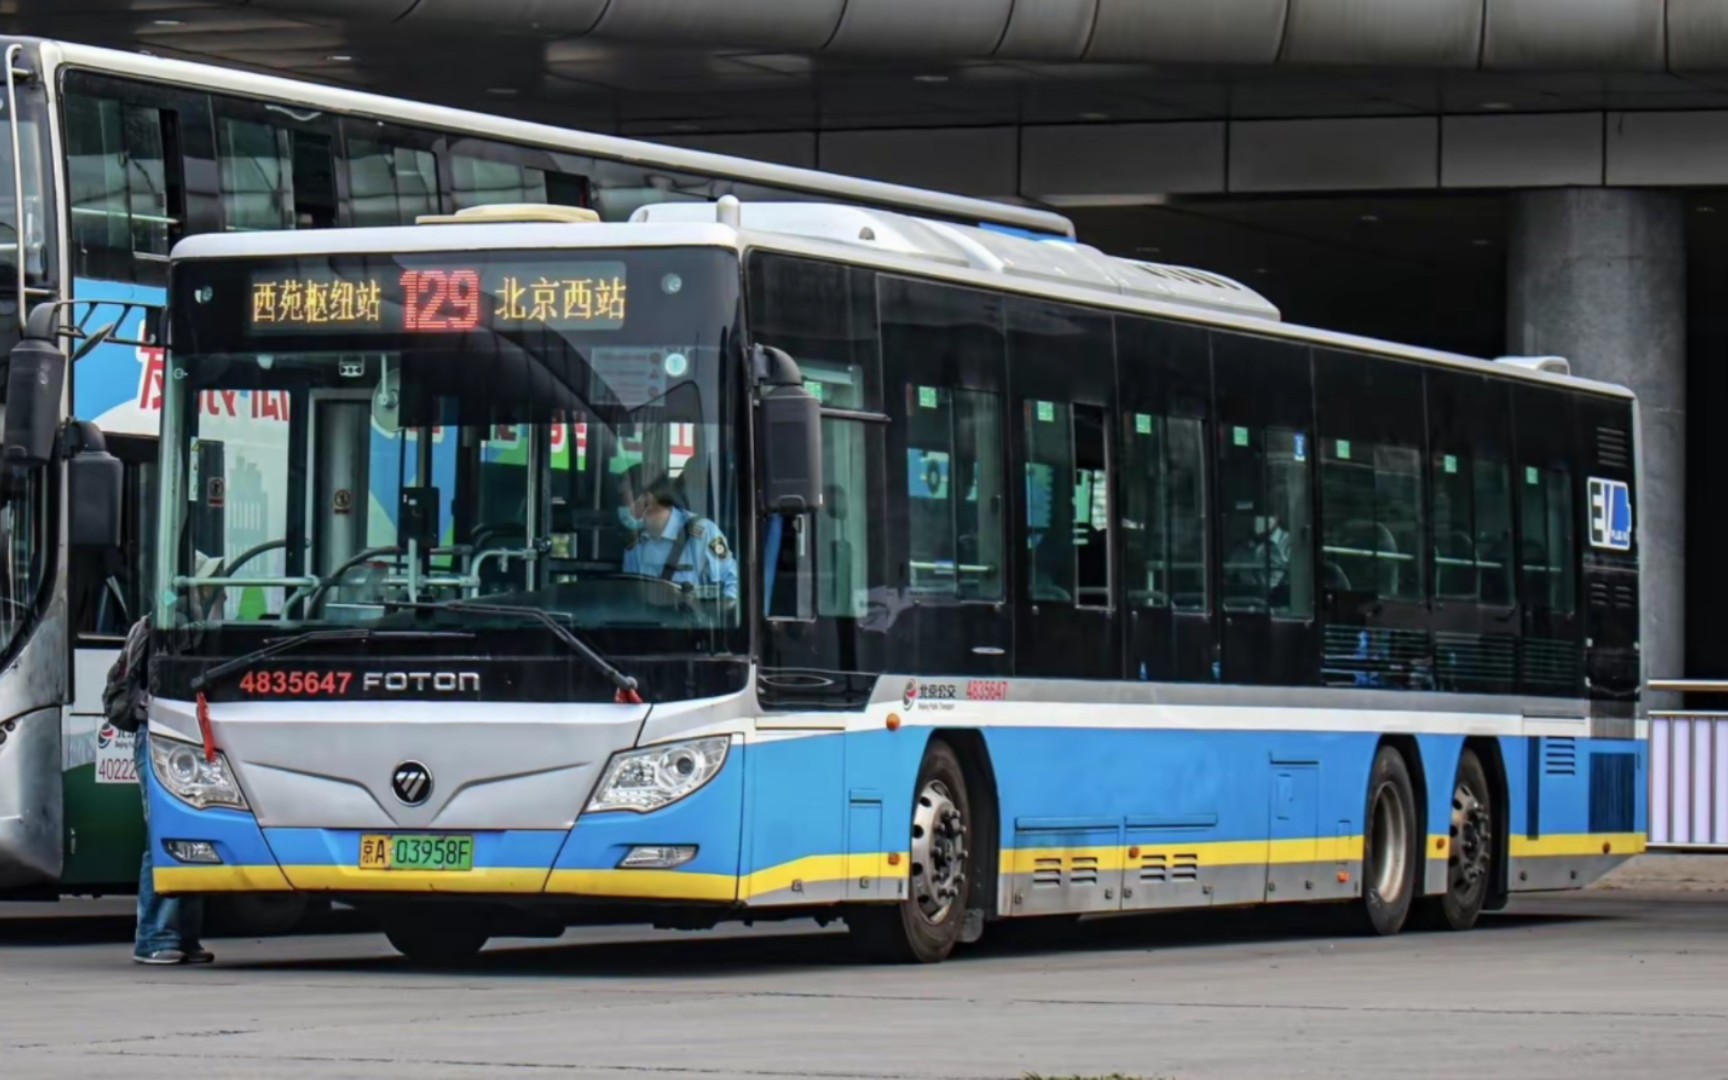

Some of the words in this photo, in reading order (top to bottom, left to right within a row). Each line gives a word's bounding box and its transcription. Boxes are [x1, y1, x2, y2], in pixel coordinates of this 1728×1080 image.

[252, 280, 381, 323] 西苑枢纽站
[399, 269, 480, 330] 129
[494, 276, 627, 321] 北京西站
[239, 670, 352, 694] 4835647
[363, 671, 480, 692] FOTON
[919, 684, 956, 699] 北京公交
[966, 680, 1008, 700] 4835647
[98, 758, 136, 780] 40222
